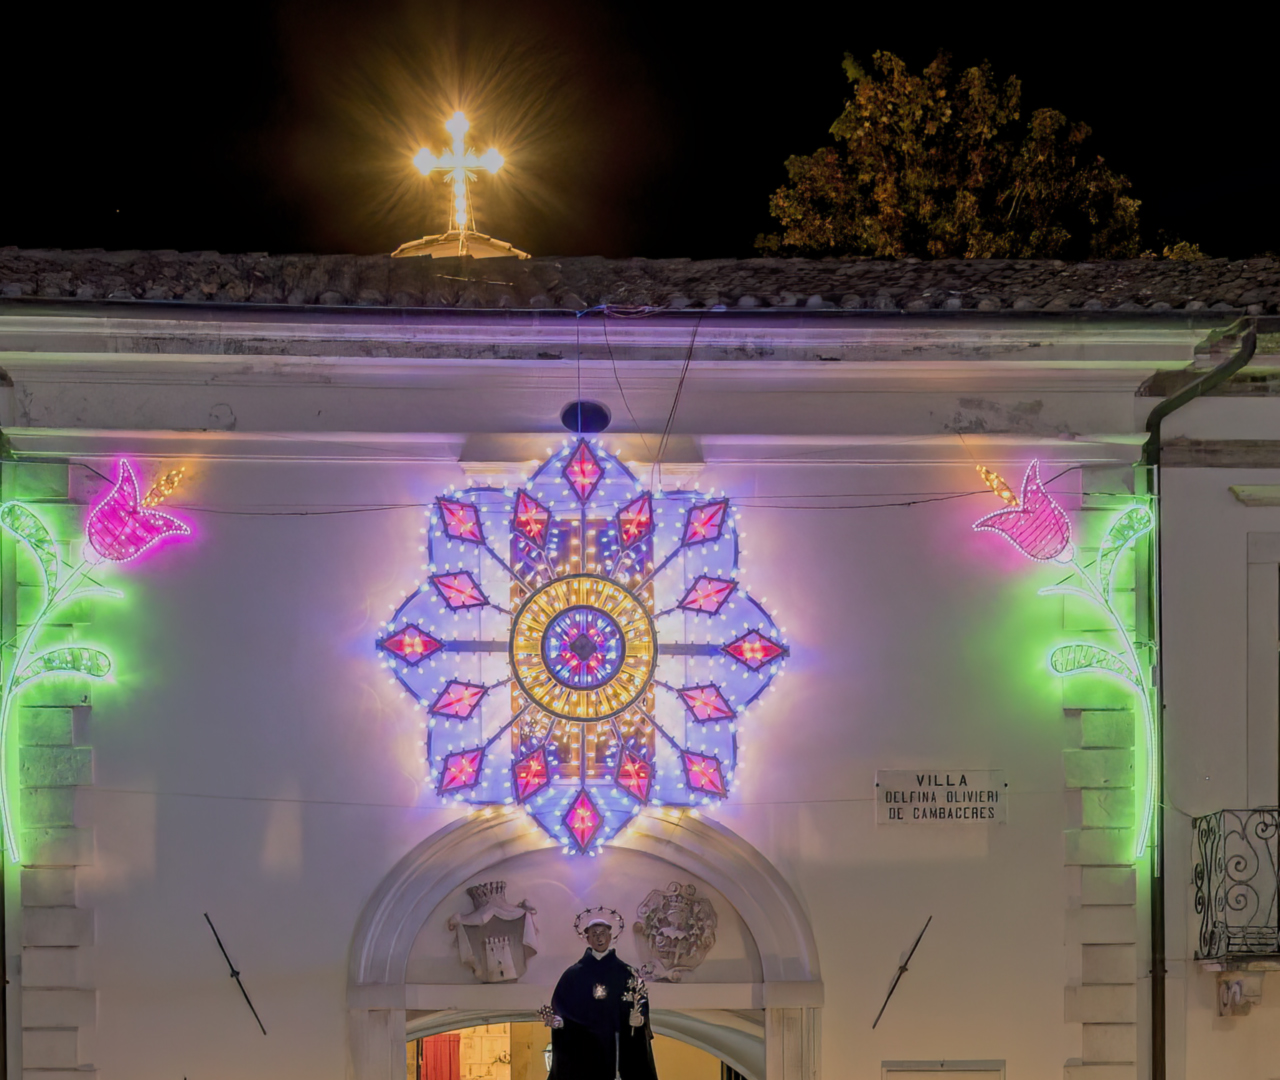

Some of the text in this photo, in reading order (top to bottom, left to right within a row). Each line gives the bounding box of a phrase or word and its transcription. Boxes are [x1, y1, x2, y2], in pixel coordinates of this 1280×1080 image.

[916, 774, 968, 787] VILLA
[885, 790, 999, 804] DELFINA OLIVIERI
[889, 806, 995, 820] DE CAMBACERES
